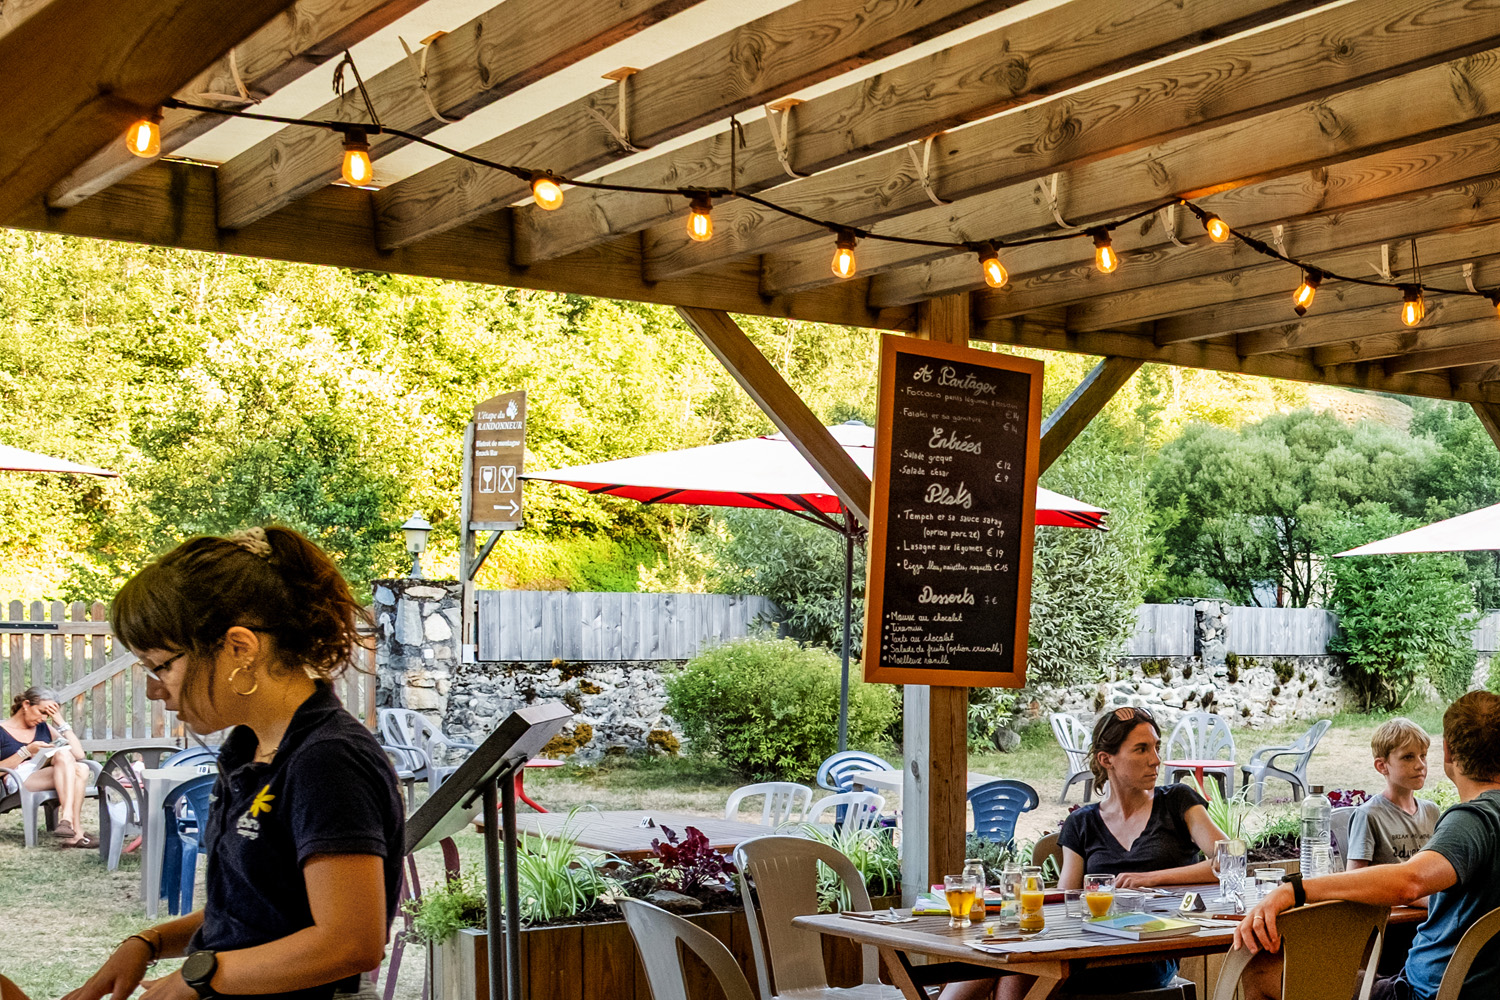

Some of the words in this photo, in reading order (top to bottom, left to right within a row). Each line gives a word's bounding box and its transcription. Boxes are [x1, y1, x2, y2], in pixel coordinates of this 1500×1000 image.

[937, 366, 997, 396] Partager
[497, 410, 506, 419] du
[477, 421, 522, 430] RANDONNEUR
[928, 426, 982, 455] Entrées
[903, 450, 925, 461] Salade
[902, 465, 925, 476] Salade
[924, 481, 973, 509] Plats
[903, 509, 934, 523] Tempeh
[947, 514, 956, 522] sa
[959, 515, 980, 523] sauce
[982, 516, 1003, 529] satay
[923, 527, 948, 539] (option
[951, 530, 967, 539] porc
[903, 540, 937, 555] Lasagne
[953, 543, 983, 555] légumes
[903, 559, 925, 576] Pizza
[918, 585, 975, 605] Desserts
[890, 611, 915, 622] Mousse
[933, 612, 964, 622] chocolat
[890, 623, 923, 632] Tiramisu
[890, 632, 908, 643] Tarte
[910, 635, 921, 643] au
[923, 632, 955, 643] chocolat
[889, 644, 915, 653] Salade
[916, 644, 925, 653] de
[927, 644, 945, 657] fruits
[946, 644, 970, 657] (option
[888, 654, 922, 665] Moelleux
[923, 655, 950, 665] vanille
[1183, 895, 1193, 908] 9
